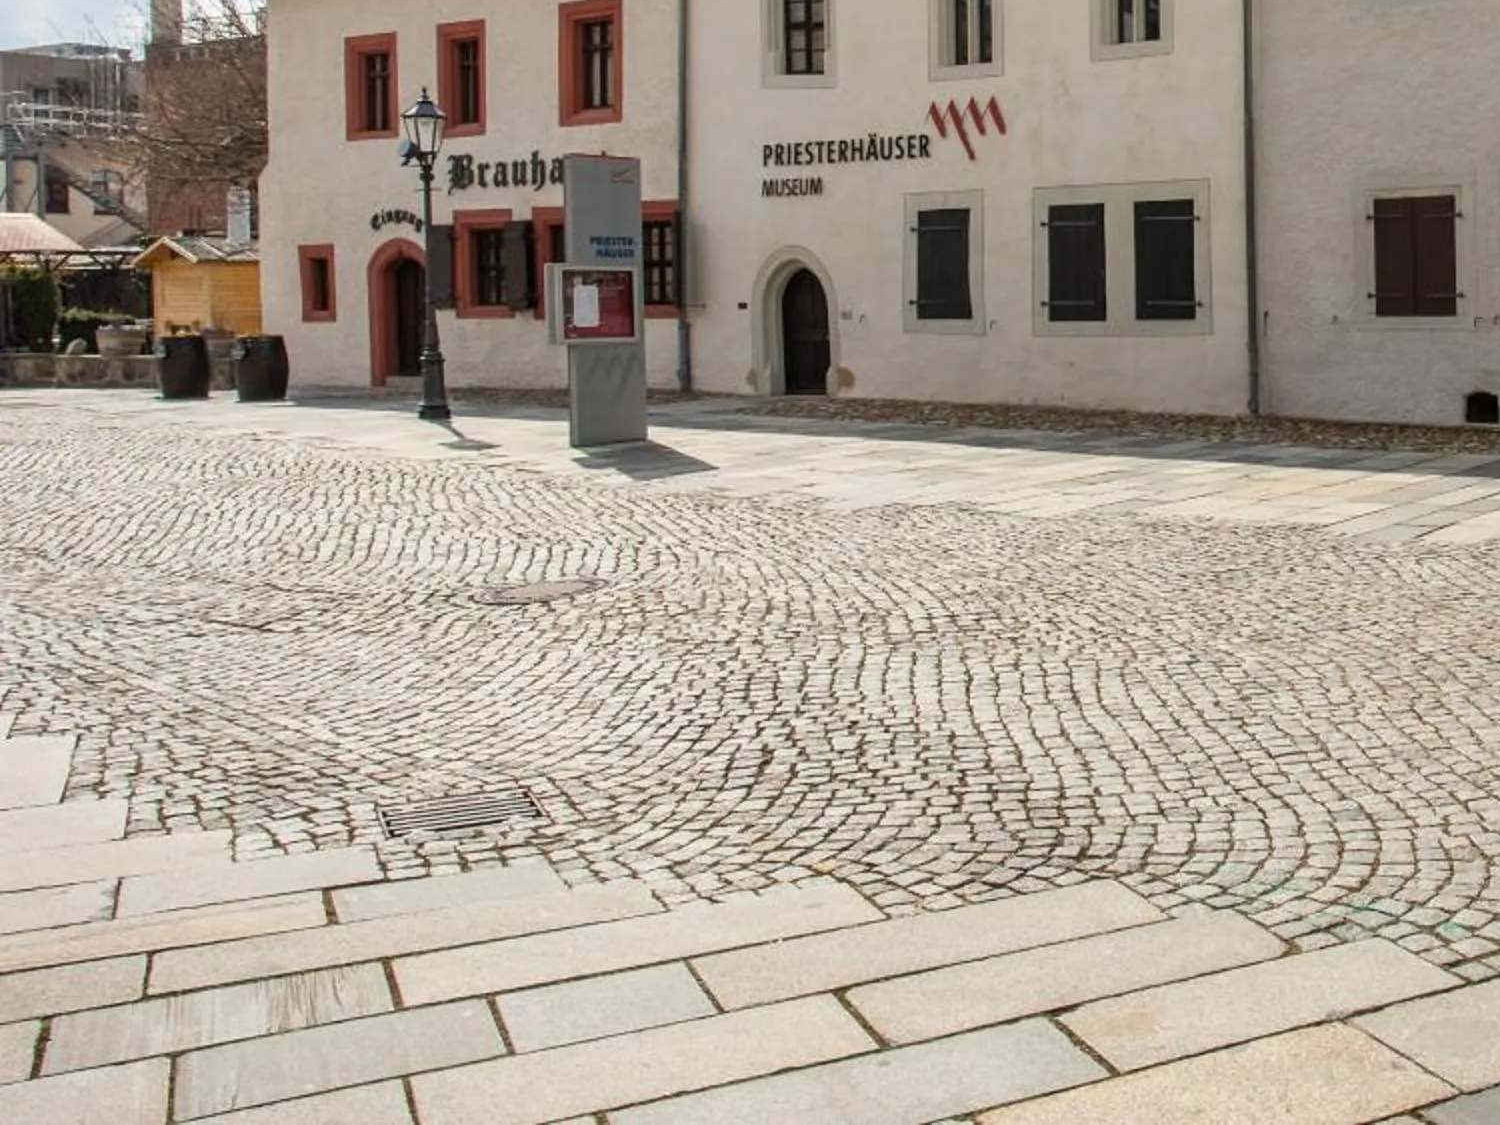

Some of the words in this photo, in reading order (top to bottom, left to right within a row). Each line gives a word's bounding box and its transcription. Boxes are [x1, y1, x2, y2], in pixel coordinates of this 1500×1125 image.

[763, 133, 931, 167] PRIESTERHÄUSER
[447, 149, 564, 196] Brauha
[761, 177, 823, 198] MUSEUM
